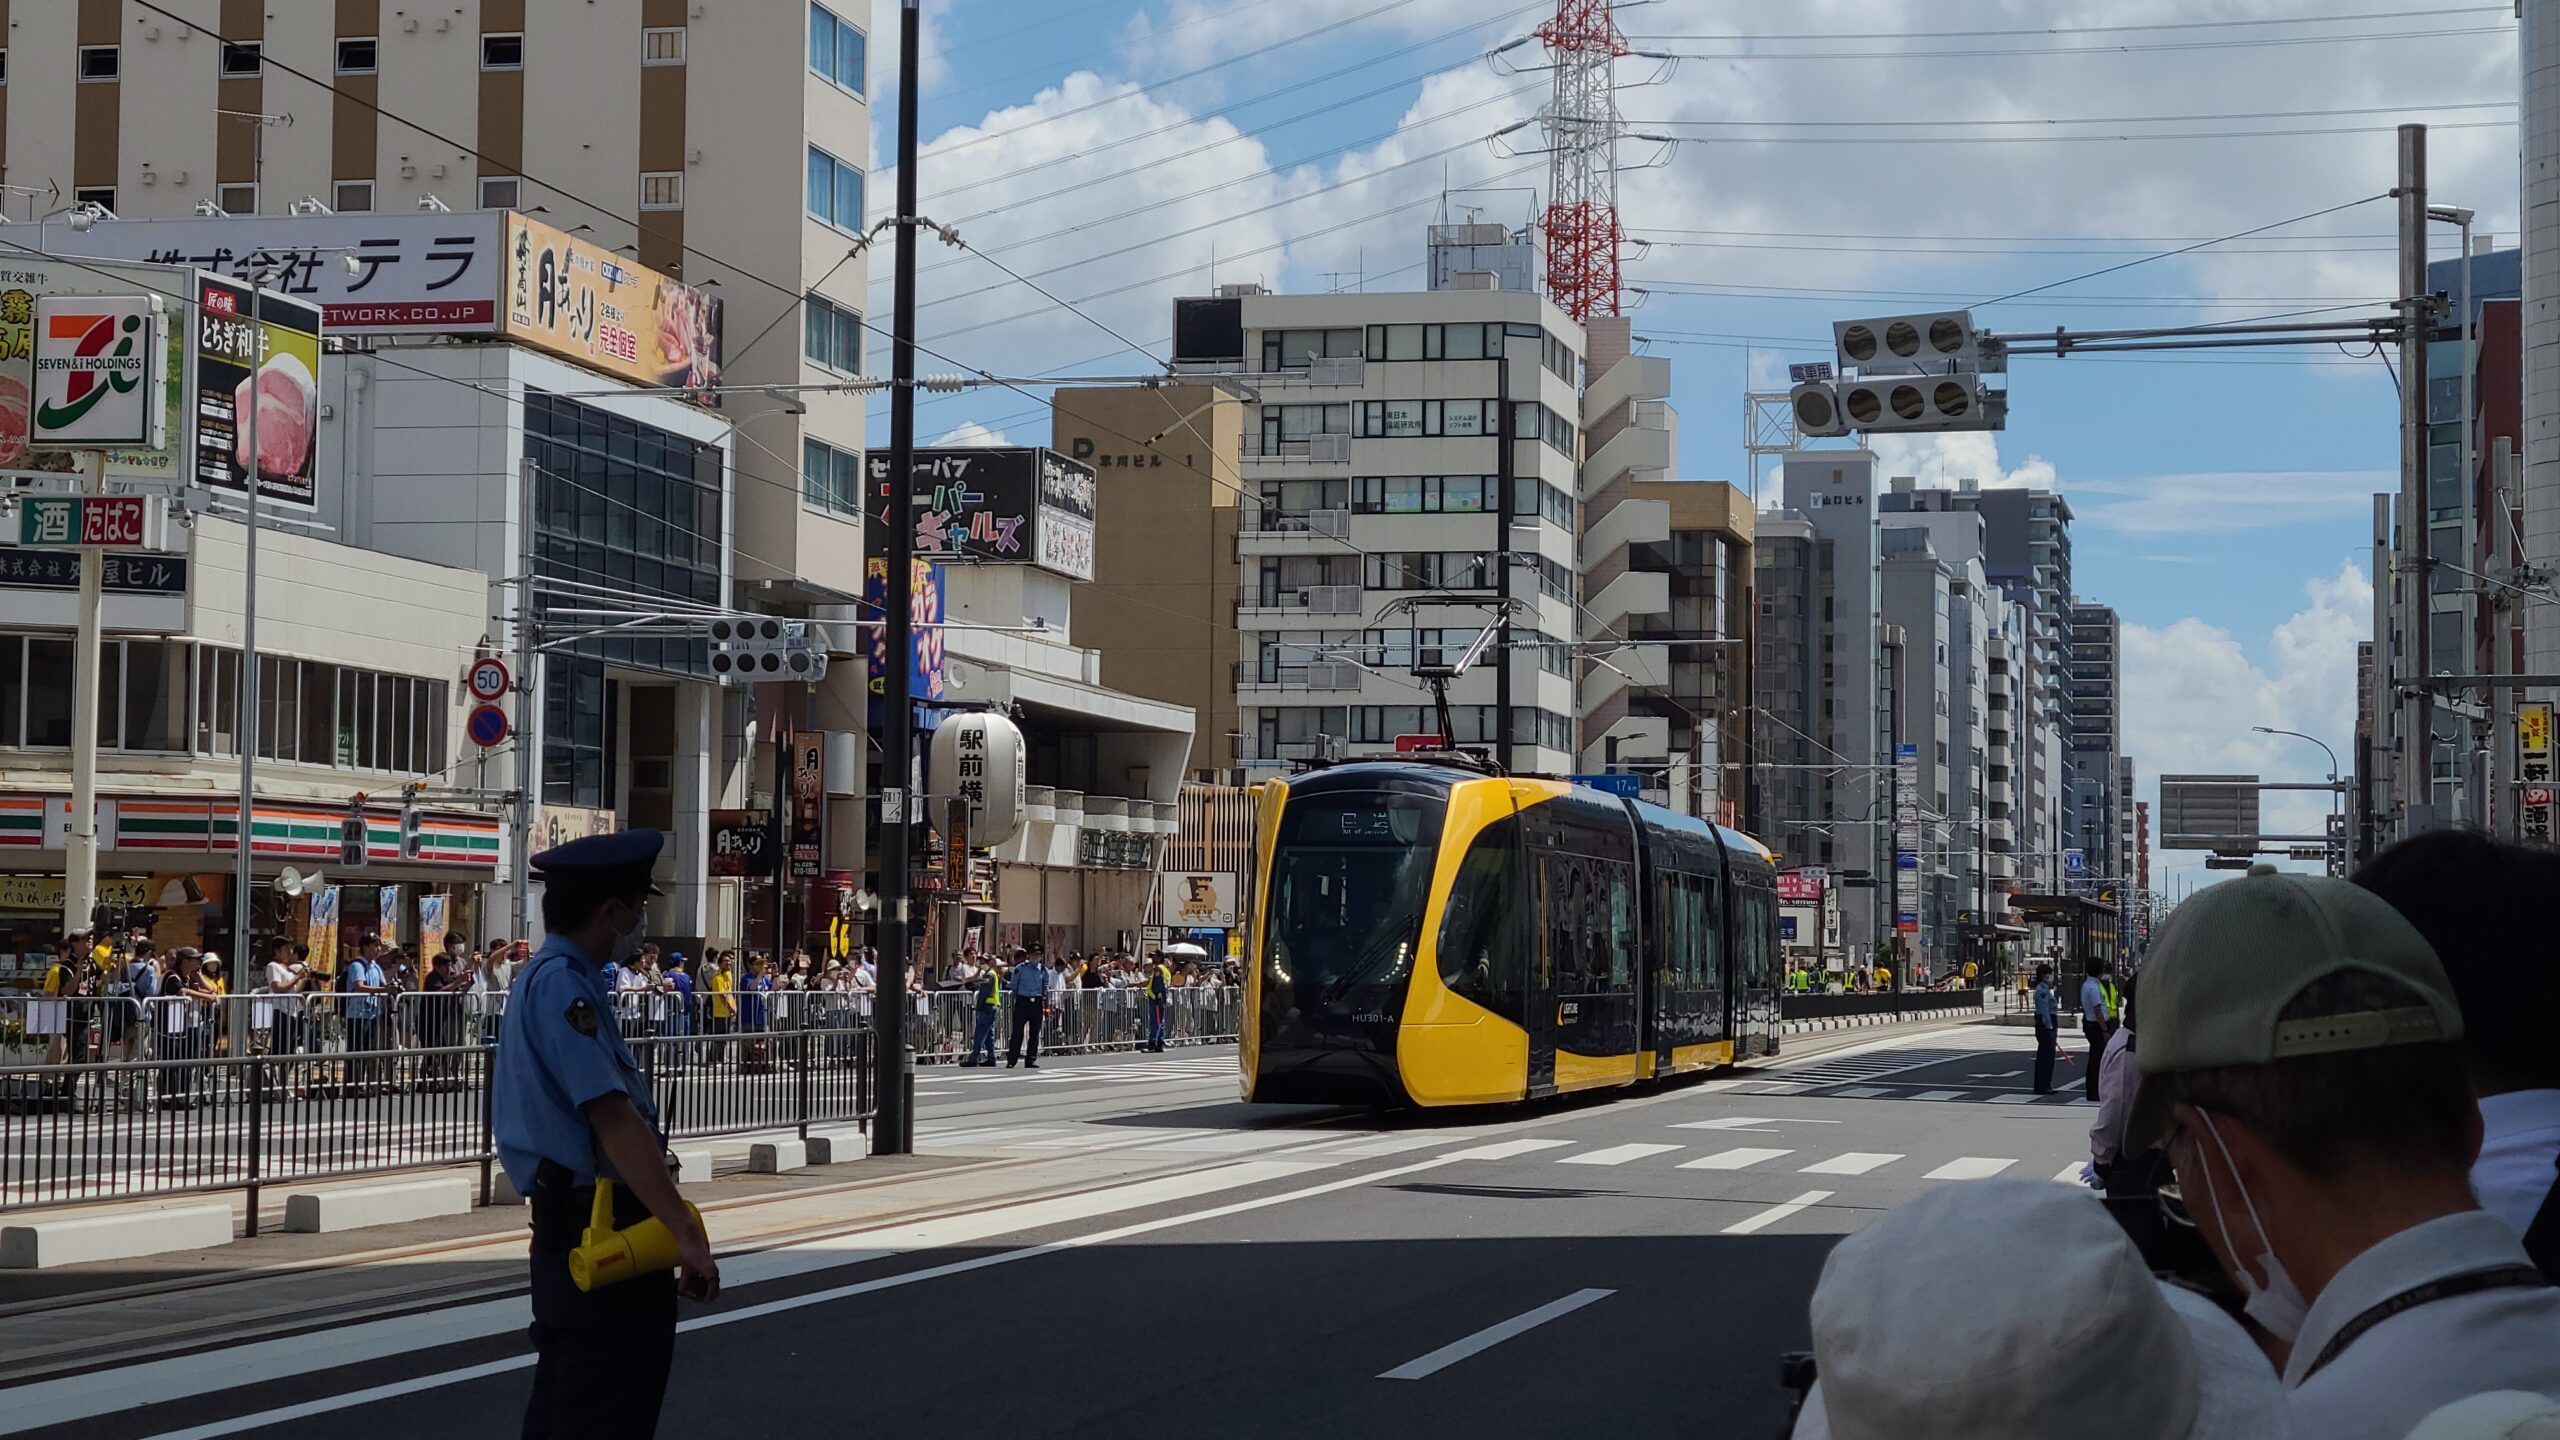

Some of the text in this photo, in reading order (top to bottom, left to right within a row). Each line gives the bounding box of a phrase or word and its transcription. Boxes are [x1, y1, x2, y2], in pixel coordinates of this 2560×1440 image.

[538, 248, 594, 341] 月あかり
[600, 323, 636, 360] 完全個室
[86, 358, 141, 369] HOLDINGS
[33, 502, 71, 542] 酒
[84, 501, 140, 541] たばこ
[916, 509, 1026, 553] ギャルズ
[477, 671, 500, 689] 50
[1352, 1014, 1394, 1023] HU301-A
